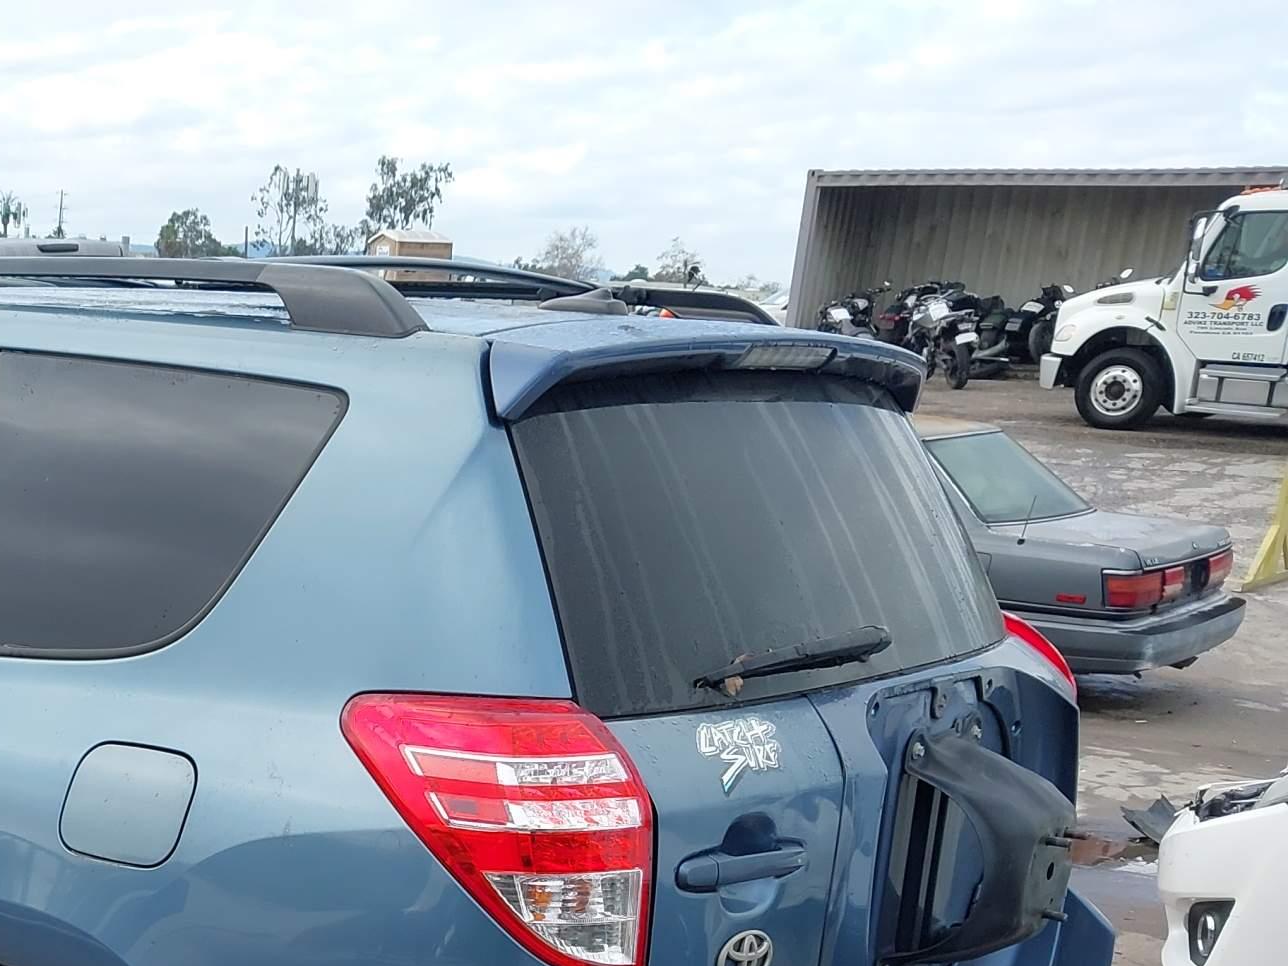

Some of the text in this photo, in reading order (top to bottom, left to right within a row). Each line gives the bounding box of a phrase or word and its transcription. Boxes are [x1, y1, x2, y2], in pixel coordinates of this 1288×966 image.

[1187, 311, 1261, 321] 323-704-6783
[696, 716, 776, 756] CATCH
[720, 742, 781, 793] SURF
